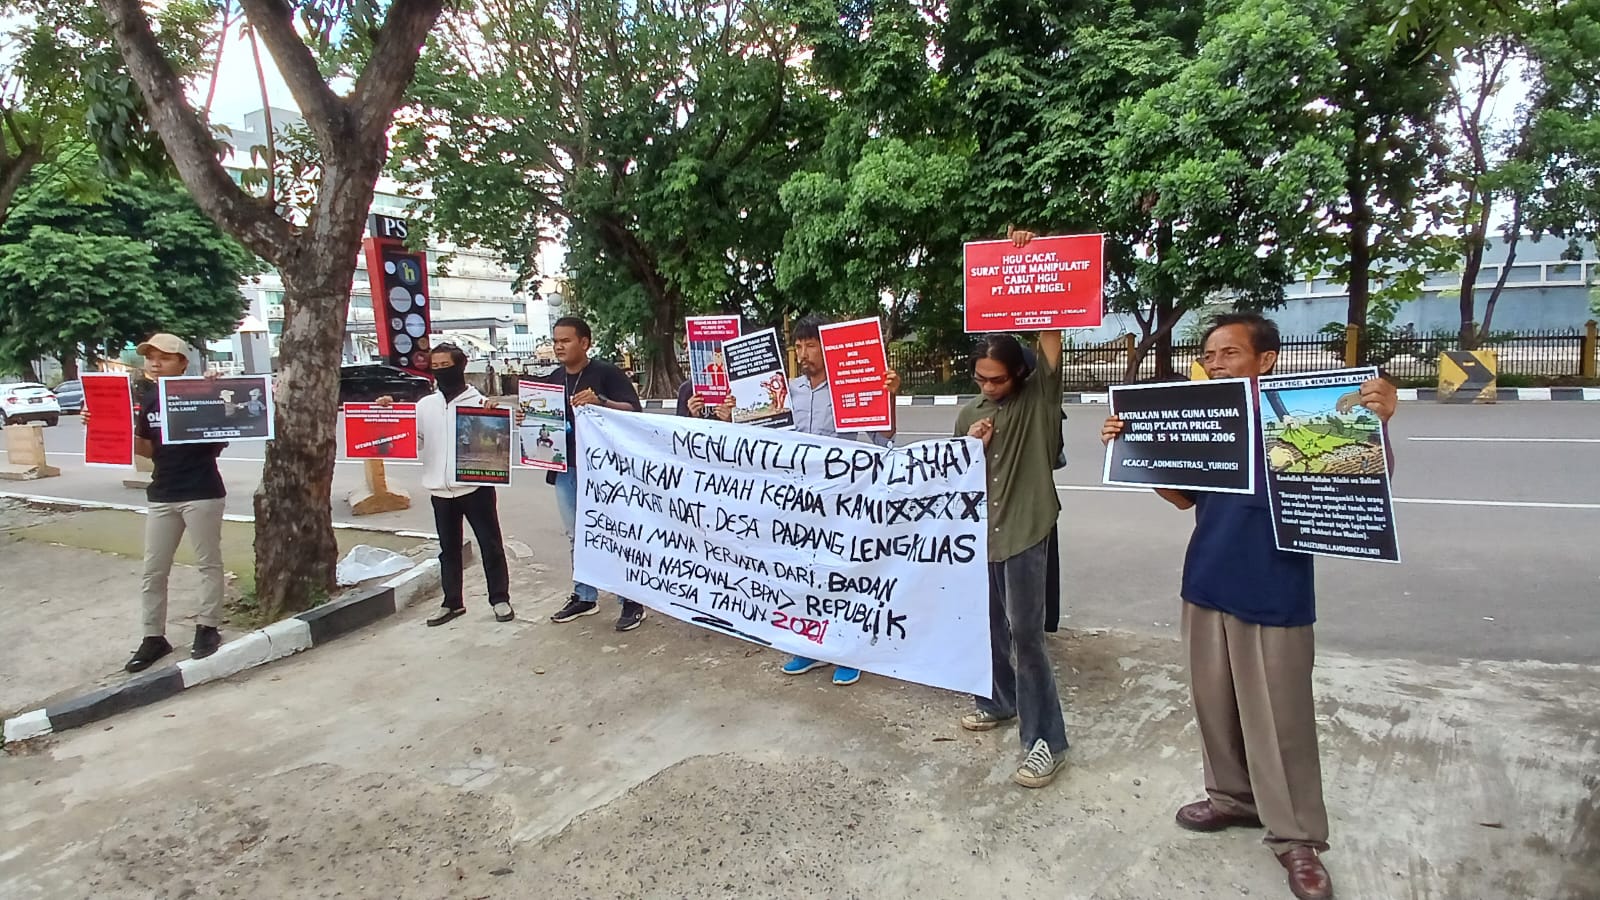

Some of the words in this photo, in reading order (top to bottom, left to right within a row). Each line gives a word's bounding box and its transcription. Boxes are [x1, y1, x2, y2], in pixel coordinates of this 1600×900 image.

[1002, 254, 1023, 265] HGU
[970, 265, 1000, 277] SURAT
[1001, 263, 1028, 275] UKUR
[1029, 260, 1091, 274] MANIPULATIF
[1003, 273, 1035, 285] CABUT
[1037, 272, 1058, 283] HGU
[991, 286, 1005, 296] PT.
[1007, 285, 1032, 295] ARTA
[1034, 283, 1066, 294] PRIGEL
[1118, 411, 1160, 420] BATALKAN
[1161, 410, 1180, 419] HAK
[1182, 409, 1206, 418] GUNA
[1207, 408, 1239, 417] USAHA
[1131, 421, 1153, 432] (HGU)
[1154, 421, 1188, 431] PT.ARTA
[1190, 420, 1222, 430] PRIGEL
[1124, 433, 1153, 442] NOMOR
[1157, 433, 1166, 442] 15
[1170, 433, 1179, 441] 14
[1181, 433, 1210, 442] TAHUN
[1211, 432, 1236, 442] 2006
[672, 430, 821, 476] MENUNTUT
[824, 447, 885, 485] BPN
[886, 439, 971, 485] LAHAT
[694, 469, 755, 501] TANAH
[760, 479, 827, 518] KEPADA
[836, 493, 883, 524] KAMI
[715, 506, 760, 539] DESA
[771, 519, 845, 556] PADANG
[850, 533, 977, 565] LENGKUAS
[584, 509, 643, 541] SEBAGAI
[646, 528, 699, 554] MANA
[828, 571, 899, 602] BADAN
[625, 567, 699, 604] INDONESIA
[709, 591, 768, 622] TAHUN
[658, 555, 737, 592] NASIONAL
[806, 594, 908, 640] REPUBLIK
